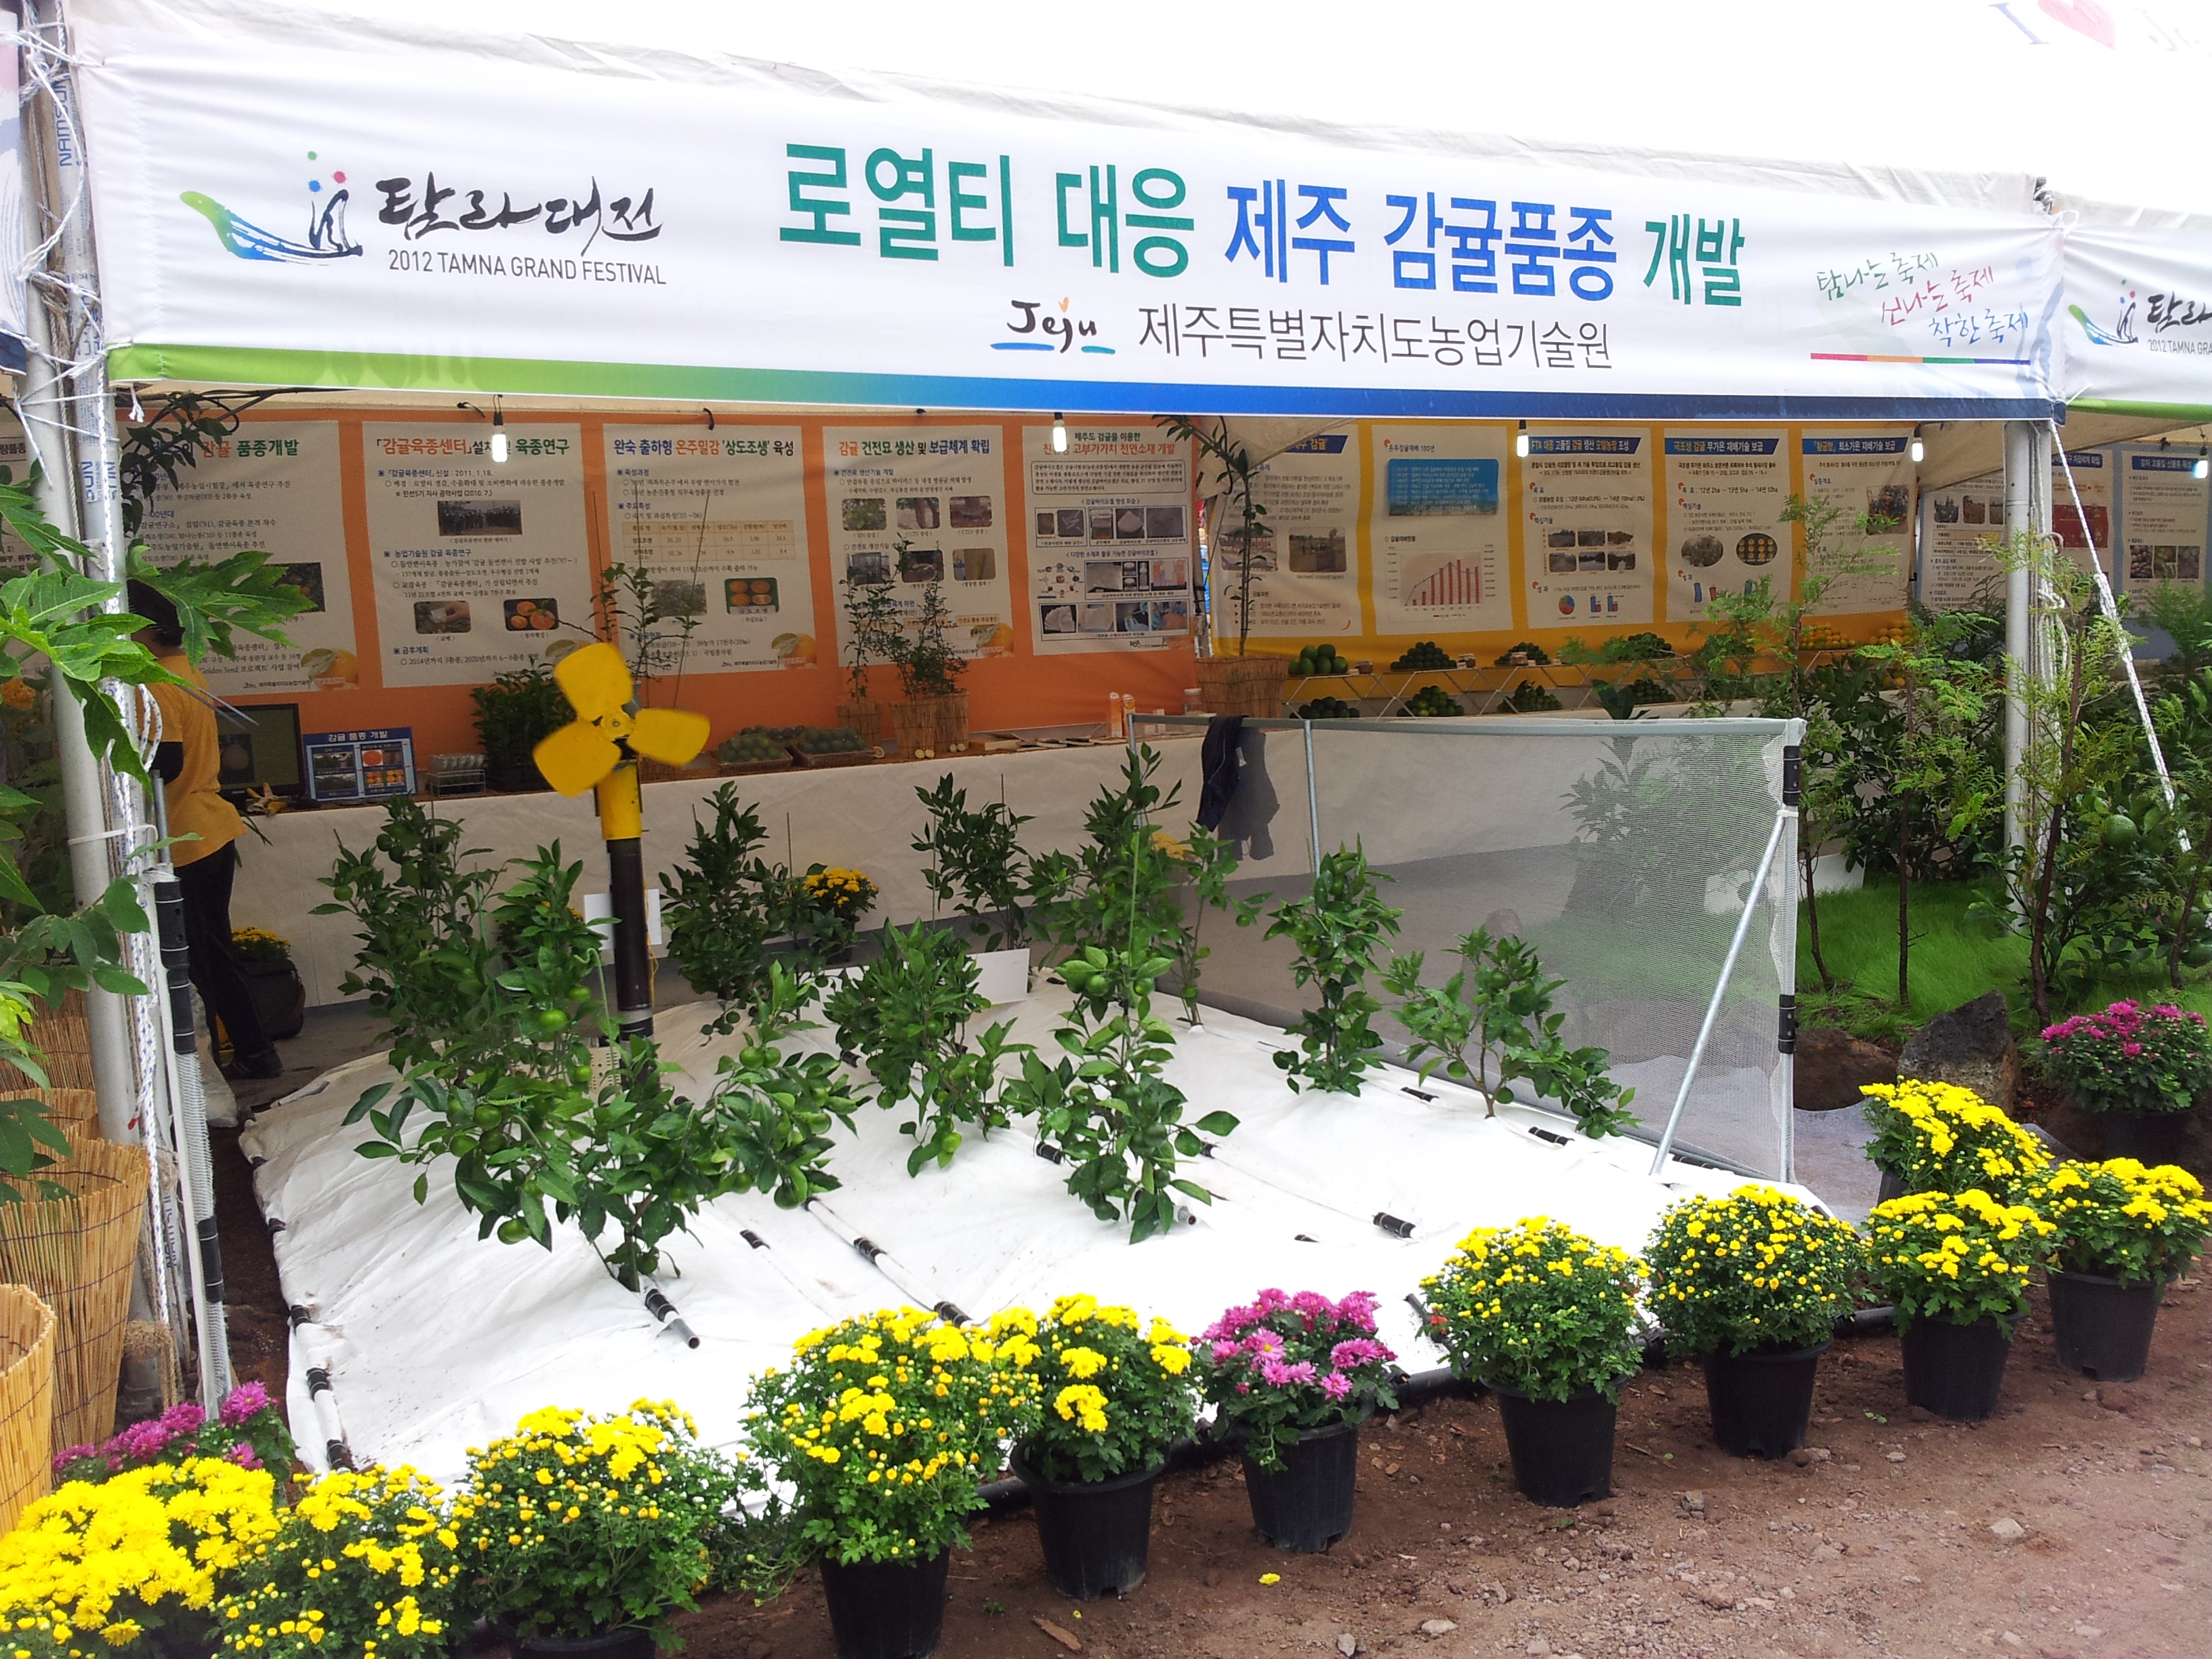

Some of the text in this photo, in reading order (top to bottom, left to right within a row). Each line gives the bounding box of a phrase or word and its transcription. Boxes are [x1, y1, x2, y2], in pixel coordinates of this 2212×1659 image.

[779, 143, 1746, 306] 로열티 대응 제주 감귤품종 개발
[389, 249, 667, 285] 2012 TAMNA GRAND FESTIVAL
[1816, 252, 1939, 300] 탐나는 축제
[1952, 266, 1994, 303] 축제
[1006, 299, 1098, 354] Jeju
[1929, 308, 2028, 347] 착한 축제
[1139, 303, 1612, 369] 제주특별자치도농업기술원
[2148, 339, 2167, 352] 2012
[2167, 340, 2196, 354] TAMNA
[1075, 432, 1095, 441] 제주도
[1120, 432, 1141, 441] 이용한
[237, 439, 299, 457] 품종개발
[516, 439, 569, 455] 육종연구
[614, 439, 636, 455] 완숙
[639, 439, 672, 455] 출하형
[676, 440, 720, 455] 온주밀감
[773, 441, 794, 456] 육성
[839, 439, 990, 456] 감귤 건전묘 생산 및 보급체계 확립
[1073, 443, 1118, 455] 고부가가치
[1120, 443, 1156, 455] 천연소재
[1158, 443, 1176, 455] 개발
[1531, 441, 1542, 451] FTA
[1584, 441, 1595, 451] 생산
[1618, 441, 1629, 451] 조성
[1752, 442, 1763, 452] 보급
